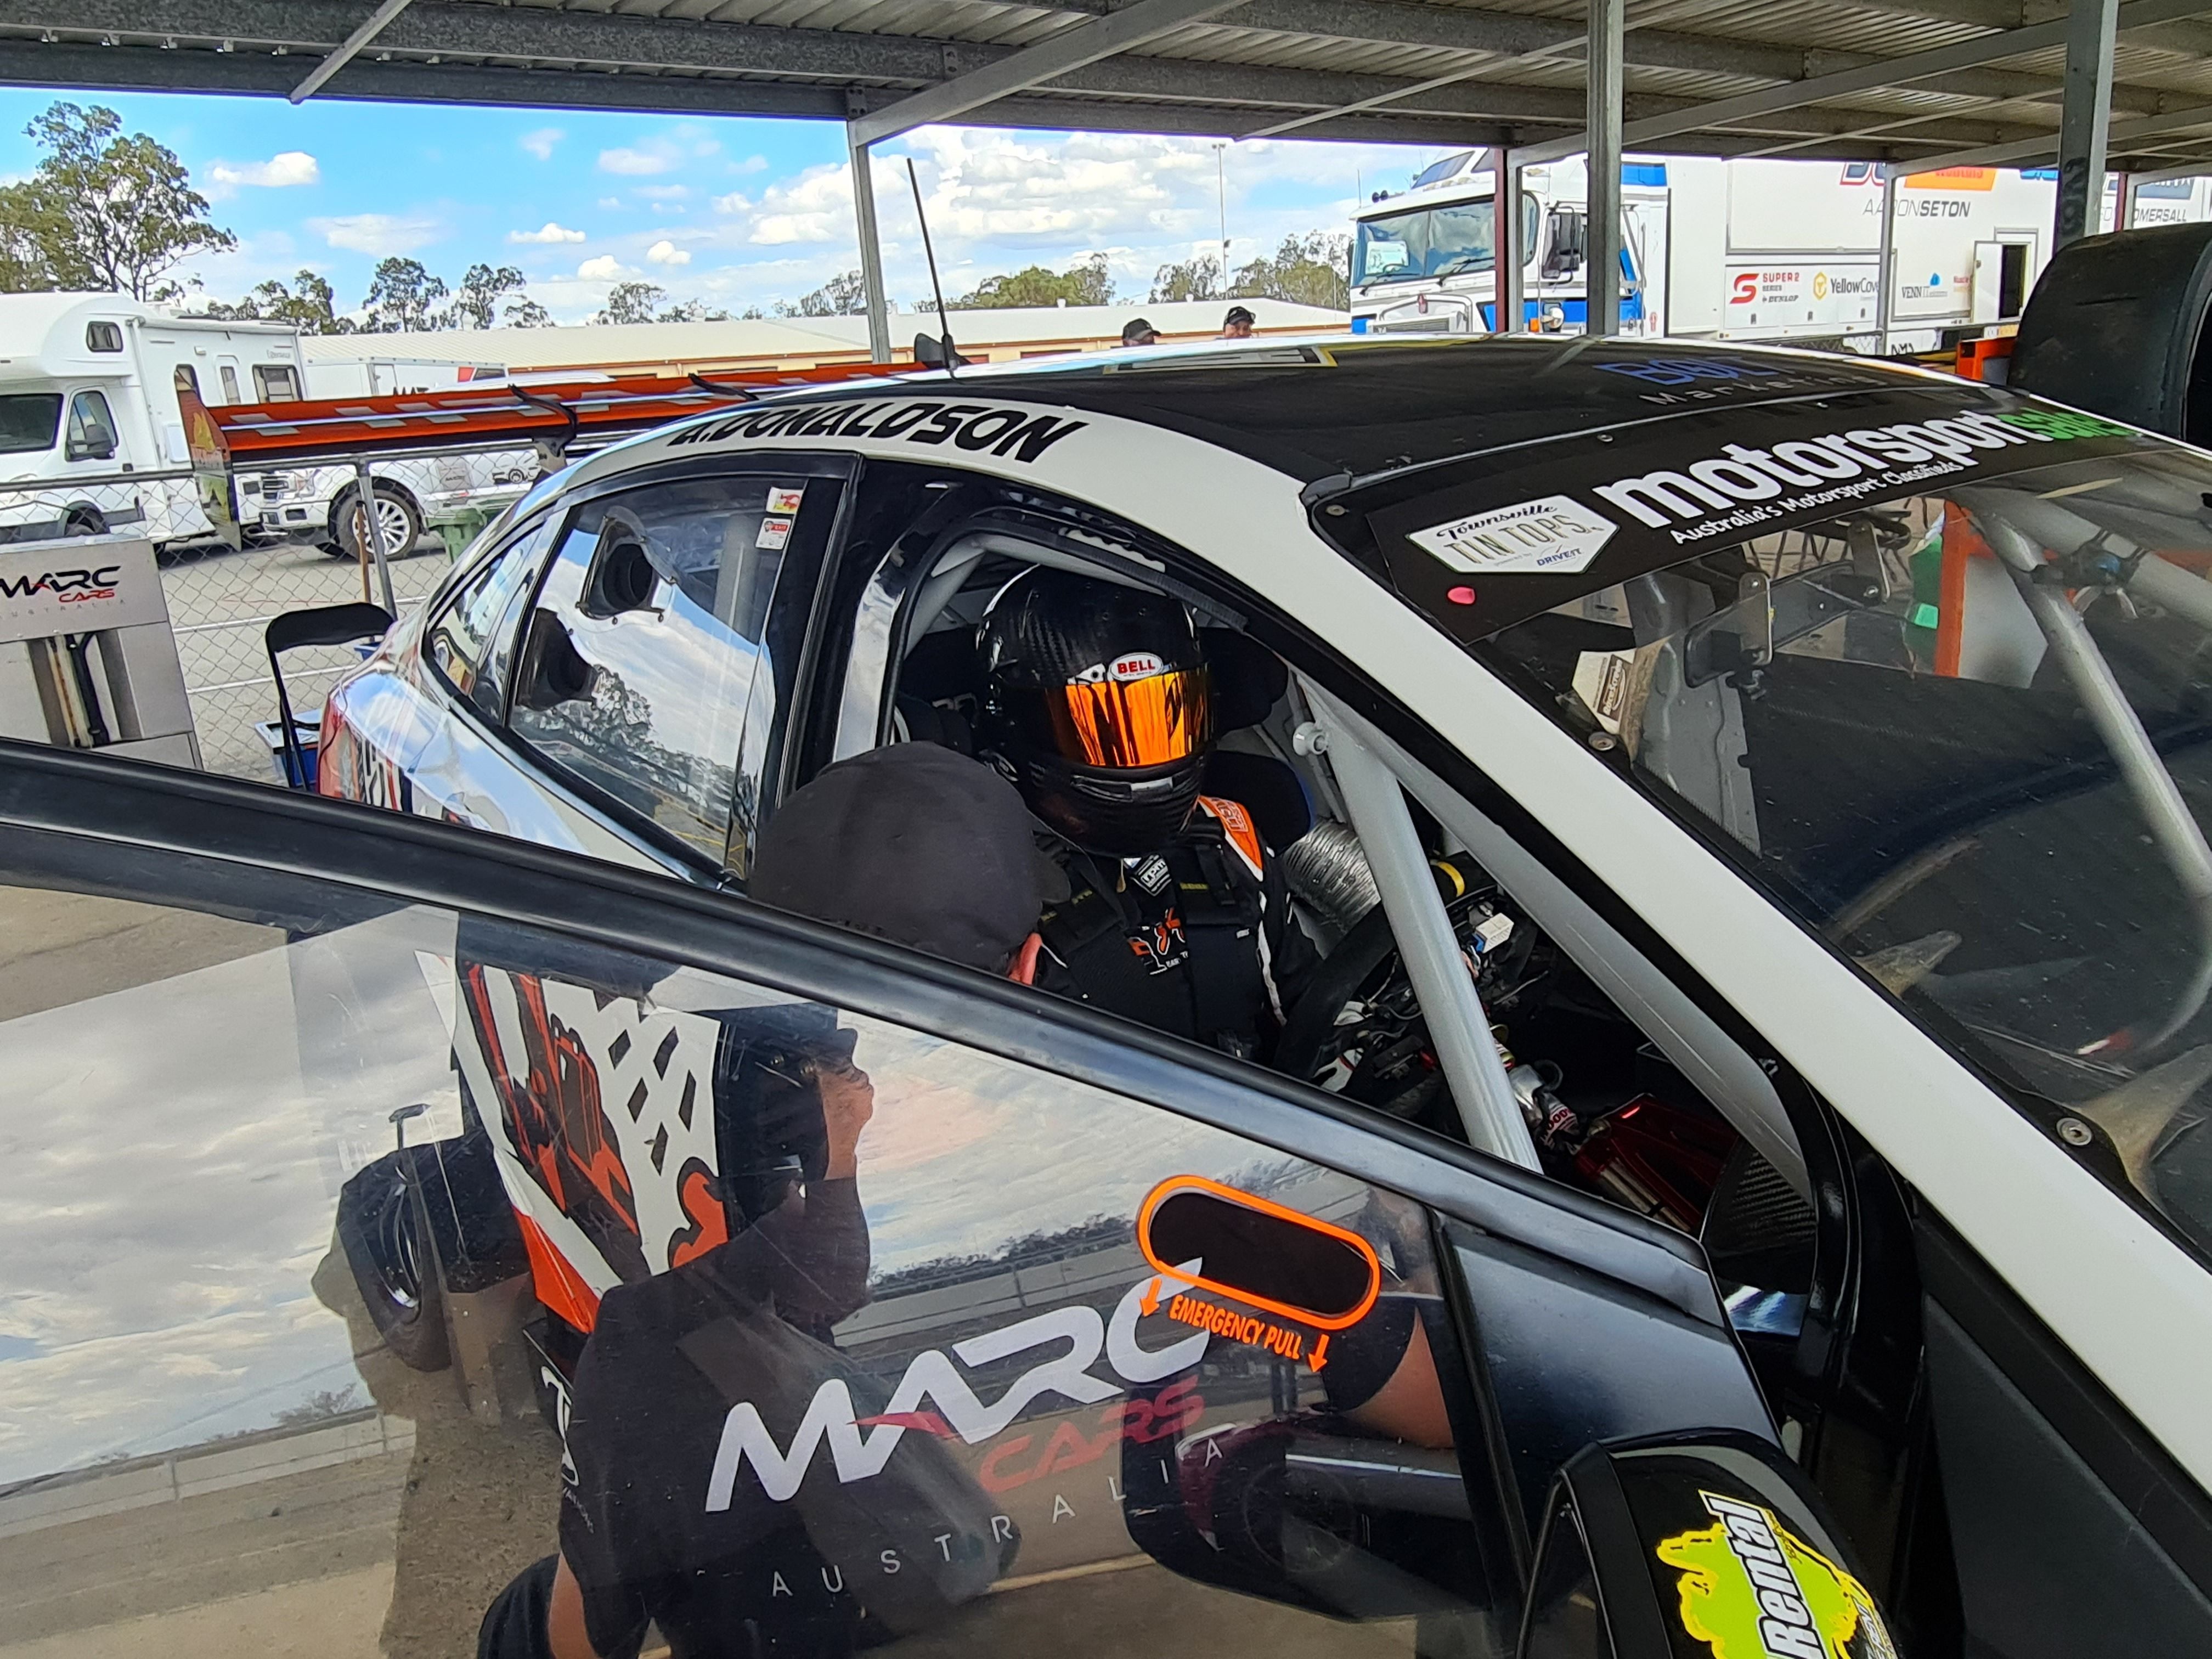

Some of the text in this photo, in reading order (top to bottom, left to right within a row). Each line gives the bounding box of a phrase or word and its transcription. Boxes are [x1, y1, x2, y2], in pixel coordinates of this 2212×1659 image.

[1436, 504, 1558, 540] Townsville
[1669, 460, 1964, 544] Australia's Motorsport Classifieds
[1444, 534, 1515, 565] TIN
[1116, 659, 1155, 674] BELL
[1169, 1294, 1303, 1360] EMERGENCY PULL
[706, 1257, 1210, 1513] MARC
[980, 1375, 1205, 1492] CARS
[771, 1438, 1223, 1598] AUSTRALIA
